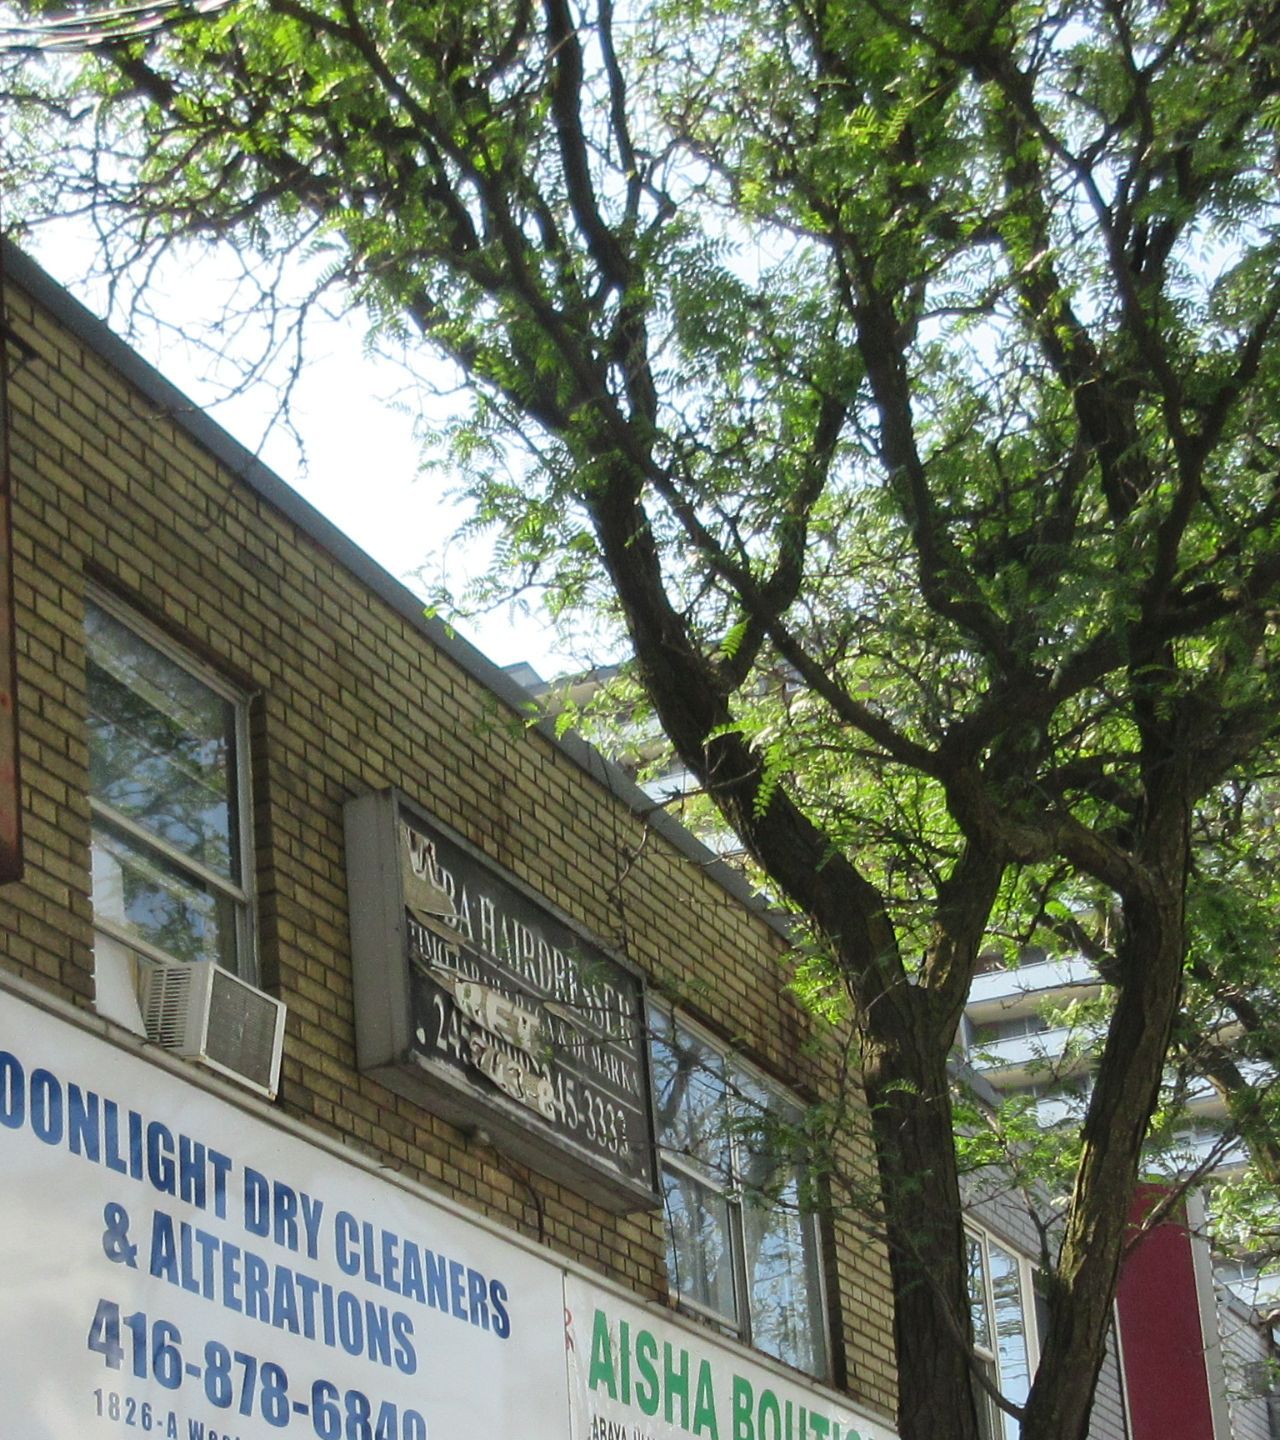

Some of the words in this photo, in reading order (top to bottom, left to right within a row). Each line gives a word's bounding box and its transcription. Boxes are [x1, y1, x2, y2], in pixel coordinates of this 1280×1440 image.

[102, 1201, 139, 1269] &
[149, 1208, 418, 1376] ALTERATIONS
[243, 1164, 325, 1260] DRY
[334, 1209, 511, 1340] CLEANERS
[93, 1387, 178, 1440] 1826-A
